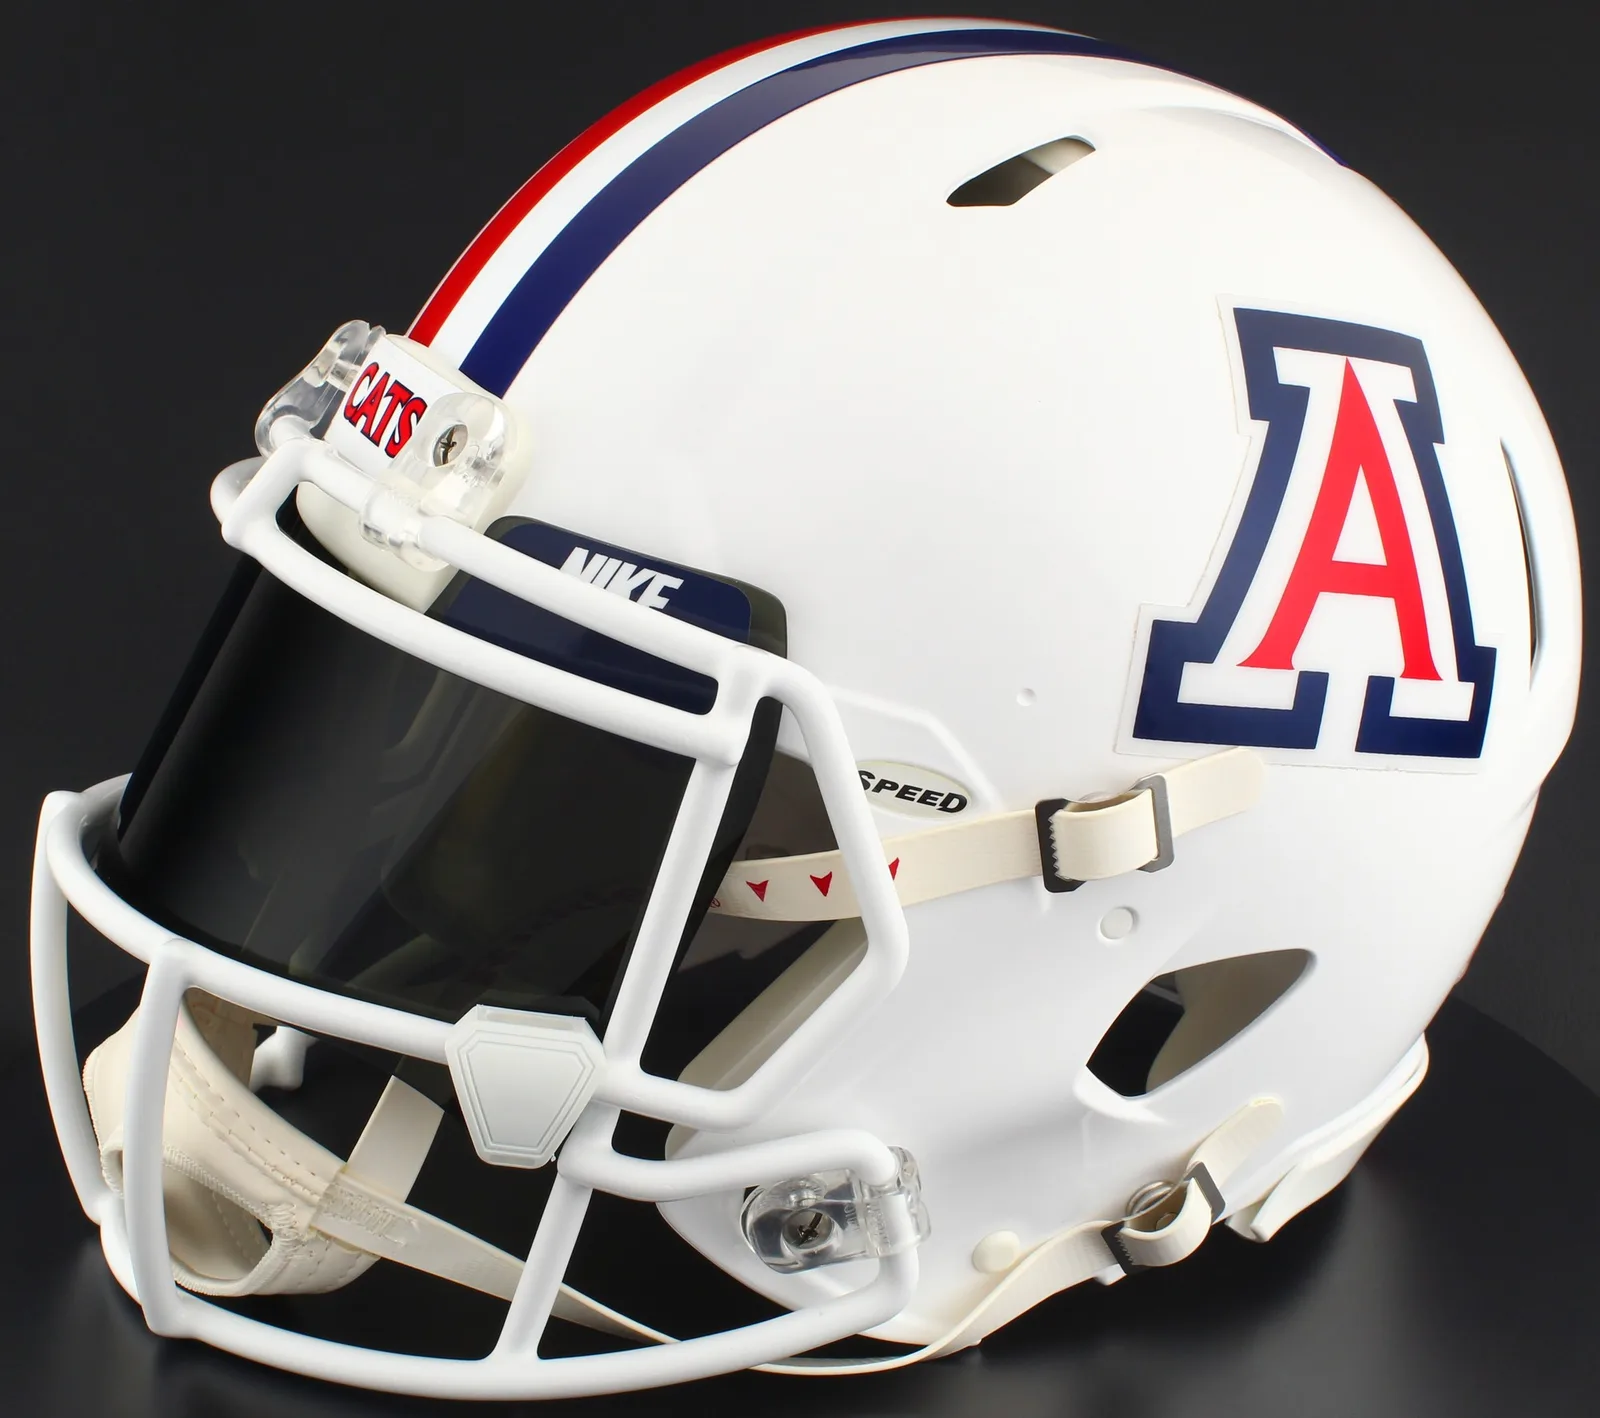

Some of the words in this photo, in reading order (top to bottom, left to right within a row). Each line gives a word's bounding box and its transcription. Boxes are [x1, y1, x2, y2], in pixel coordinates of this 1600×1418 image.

[343, 362, 428, 458] CATS
[1133, 308, 1497, 758] A
[560, 546, 684, 609] NIKE
[858, 770, 967, 813] SPEED
